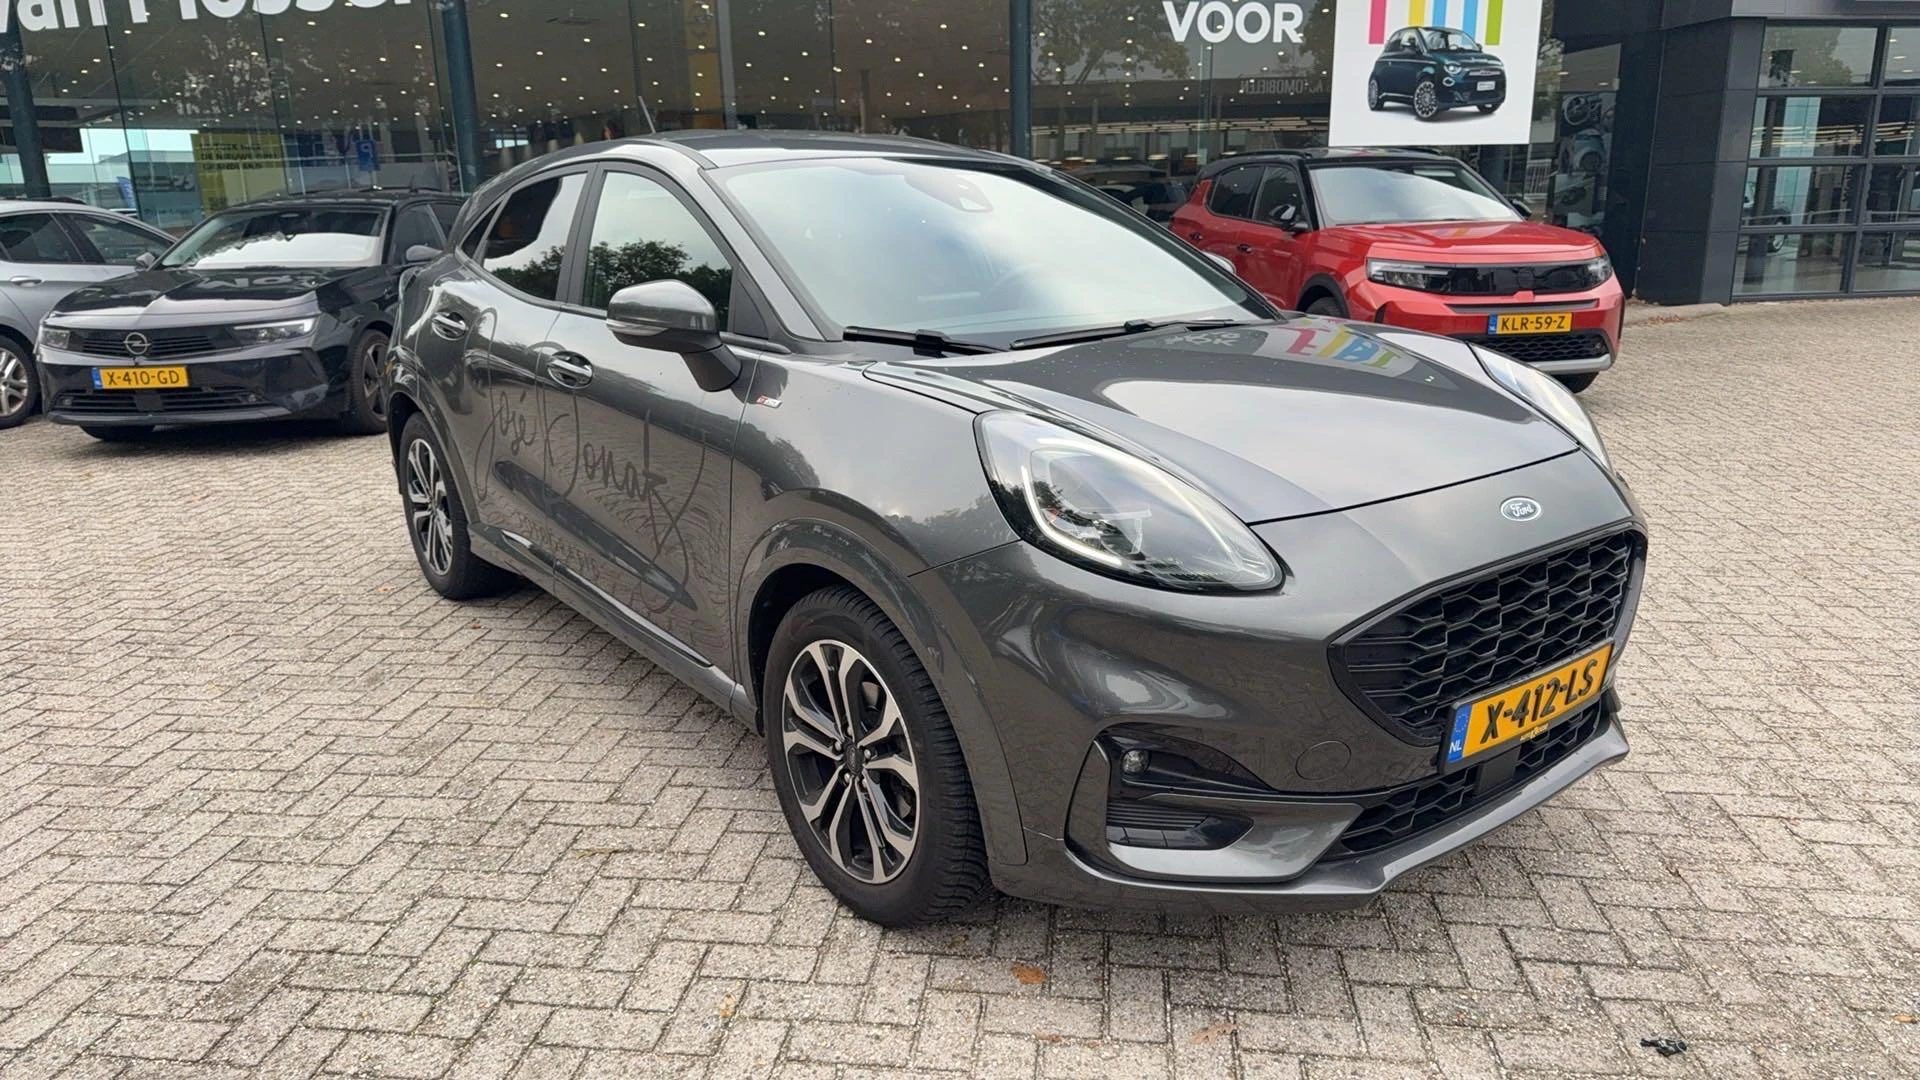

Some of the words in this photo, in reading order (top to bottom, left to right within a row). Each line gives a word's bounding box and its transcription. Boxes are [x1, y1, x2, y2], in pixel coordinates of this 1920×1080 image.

[1162, 1, 1304, 44] VOOR
[1500, 315, 1566, 331] KLR-59-Z
[107, 370, 180, 386] X-410-GD
[1510, 502, 1535, 517] Ford
[1480, 658, 1598, 745] X-412-LS
[1449, 739, 1462, 754] NL
